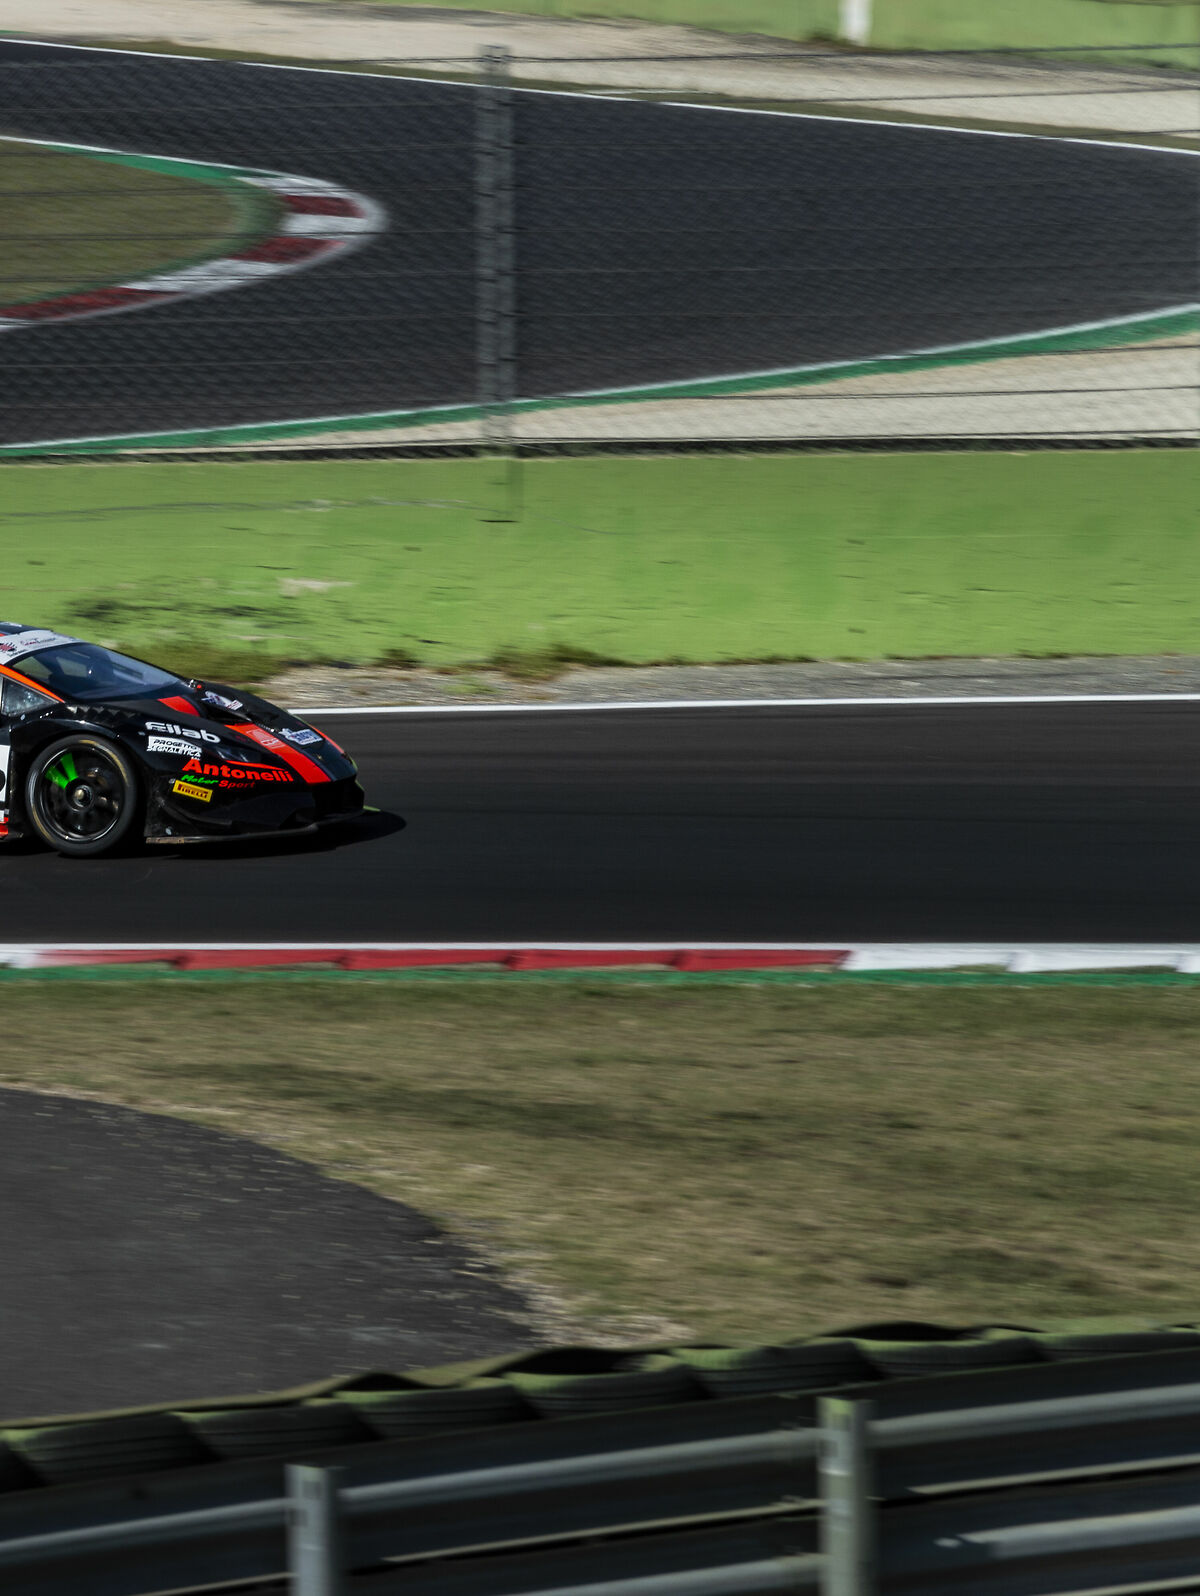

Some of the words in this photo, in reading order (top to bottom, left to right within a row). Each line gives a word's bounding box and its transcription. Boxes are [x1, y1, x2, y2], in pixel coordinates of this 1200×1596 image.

[154, 739, 198, 750] PROGETTO
[182, 759, 294, 782] Antonelli
[181, 774, 218, 785] Motor
[218, 780, 255, 789] Sport
